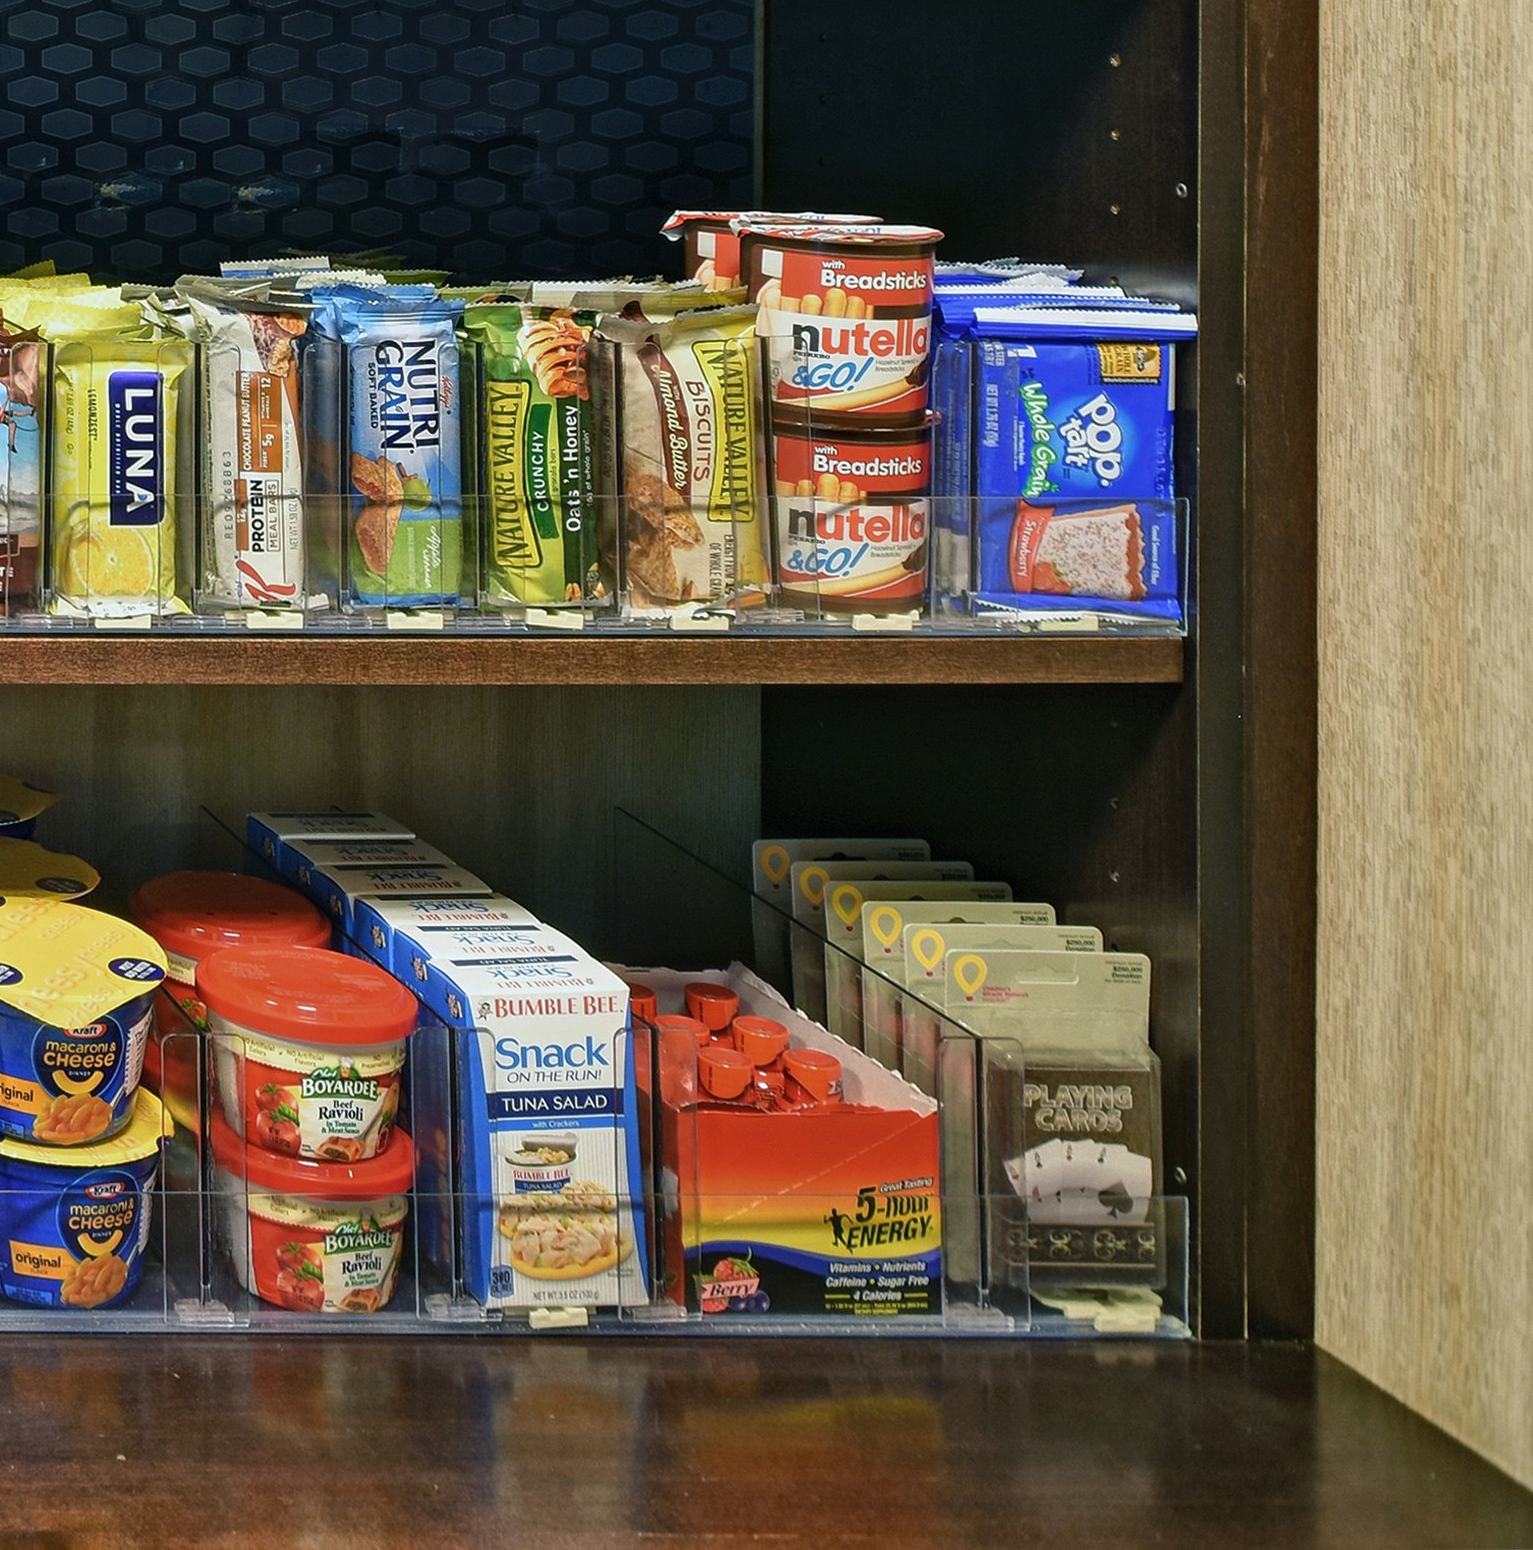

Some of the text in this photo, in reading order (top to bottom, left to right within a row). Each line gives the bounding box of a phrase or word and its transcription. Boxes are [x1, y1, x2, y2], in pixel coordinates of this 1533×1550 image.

[821, 269, 926, 291] Breadsticks
[792, 318, 927, 356] nutella
[375, 340, 413, 451] GRAIN
[402, 340, 440, 450] NUTRI
[123, 388, 155, 513] LUNA
[492, 385, 533, 562] NATURE VALLEY
[535, 431, 548, 512] CRUNCHY
[564, 406, 582, 532] Oats 'n Honey
[815, 456, 922, 475] Breadsticks
[251, 480, 265, 552] PROTEIN
[789, 504, 925, 541] nutella
[1017, 520, 1037, 579] Strawberry
[495, 998, 579, 1017] BUMBLE
[46, 1040, 108, 1054] macaroni
[496, 1036, 608, 1071] Snack
[301, 1075, 378, 1097] BOYARDEE
[507, 1069, 601, 1083] ON THE RUN!
[502, 1094, 607, 1112] TUNA SALAD
[1024, 1085, 1133, 1109] PLAYING
[318, 1107, 364, 1121] Ravioli
[1034, 1108, 1122, 1133] CARDS
[848, 1217, 933, 1251] ENERGY
[826, 1276, 867, 1288] Caffeine
[830, 1262, 925, 1273] Vitamins Nutrients
